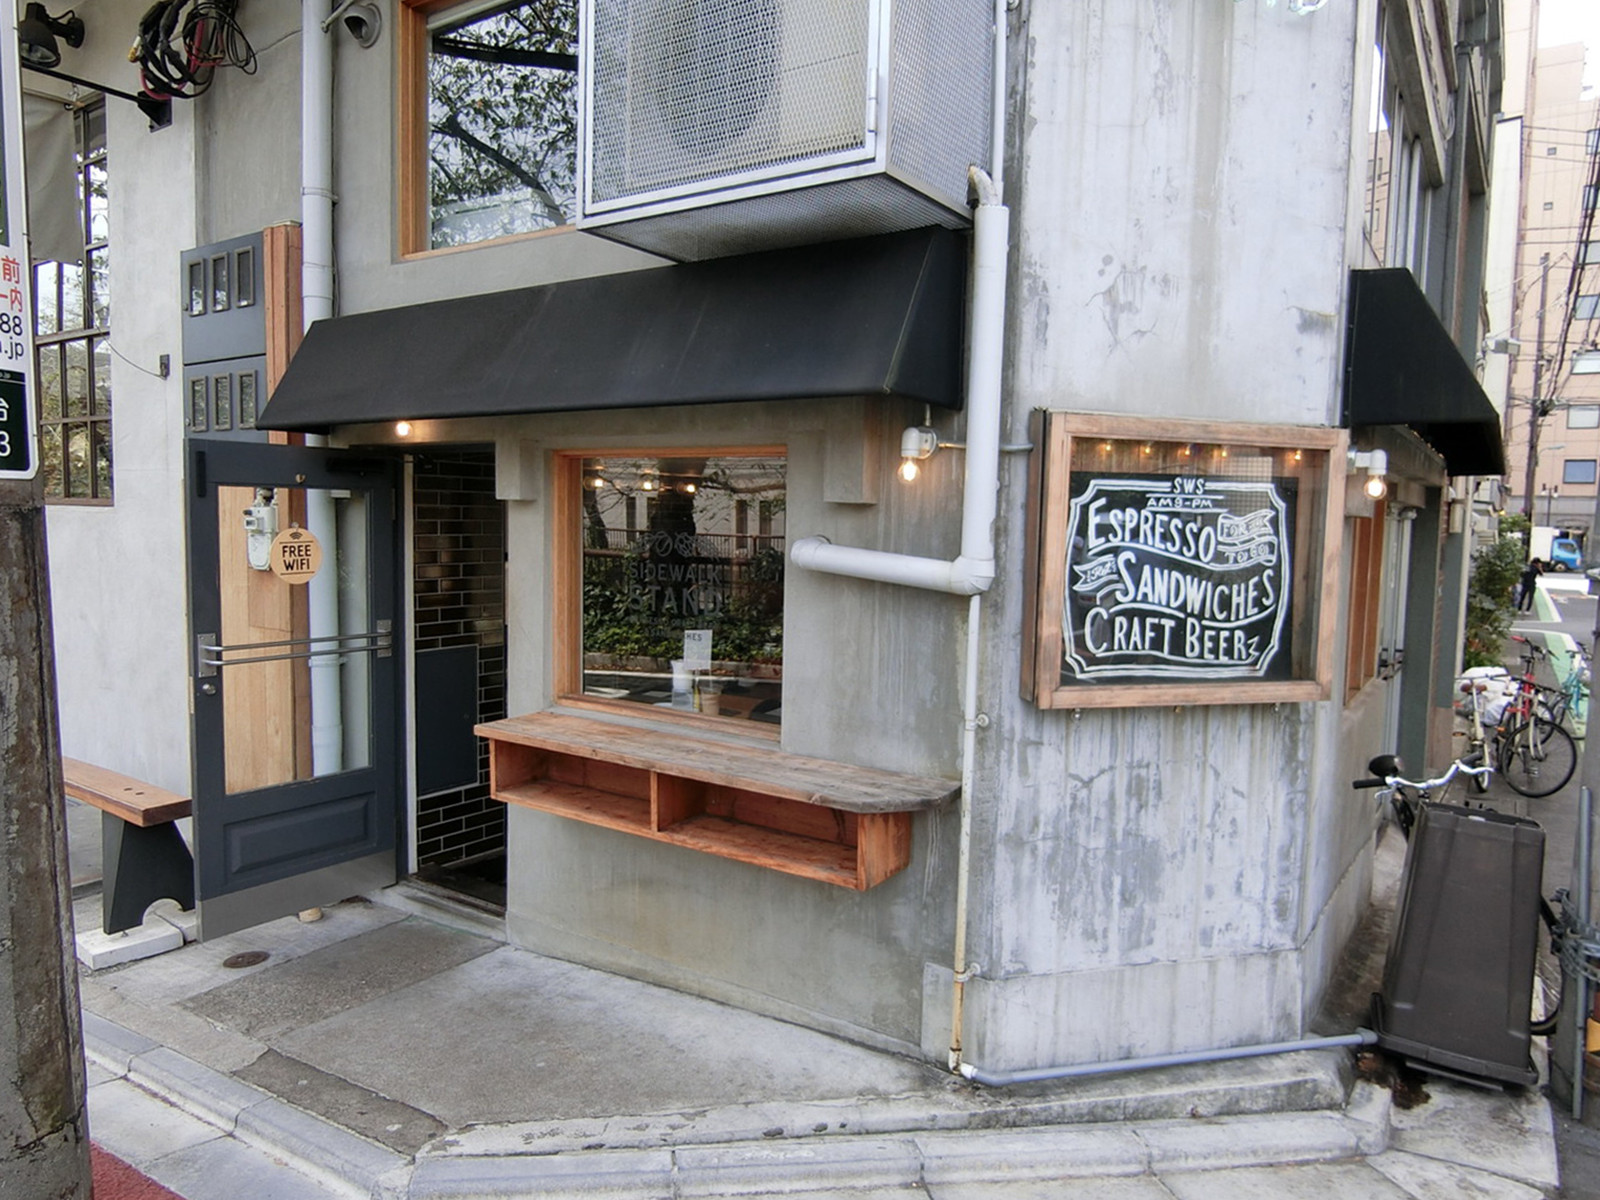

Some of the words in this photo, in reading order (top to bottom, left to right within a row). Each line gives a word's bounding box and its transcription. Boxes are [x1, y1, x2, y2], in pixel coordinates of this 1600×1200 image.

[1, 255, 20, 285] 前
[1173, 476, 1205, 495] SWS
[1087, 497, 1216, 563] ESPRESSO
[282, 544, 311, 558] FREE
[283, 558, 310, 571] WIFI
[629, 562, 721, 584] SIDEWALK
[1115, 551, 1275, 621] SANDWICHES
[629, 584, 721, 616] STAND
[1084, 606, 1175, 656] CRAFT
